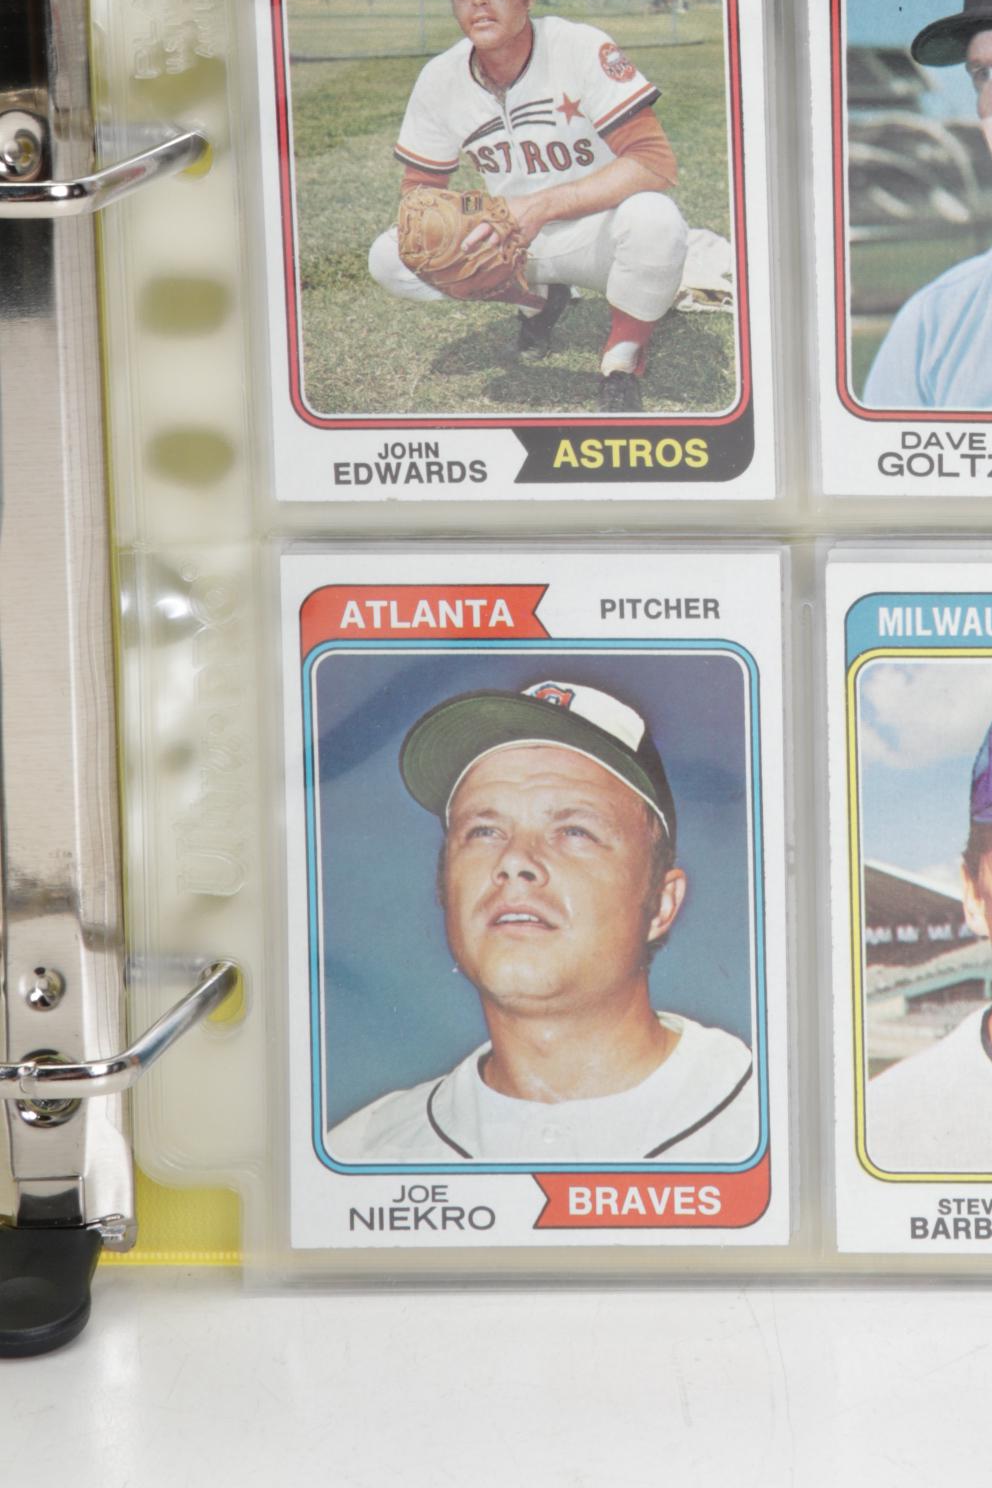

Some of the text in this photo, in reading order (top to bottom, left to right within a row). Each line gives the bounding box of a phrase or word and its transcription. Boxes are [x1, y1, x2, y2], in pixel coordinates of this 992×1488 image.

[377, 441, 440, 461] JOHN
[553, 437, 709, 469] ASTROS
[901, 431, 987, 451] DAVE
[333, 459, 488, 486] EDWARDS
[339, 598, 514, 629] ATLANTA
[600, 597, 720, 620] PITCHER
[392, 1184, 449, 1204] JOE
[568, 1185, 722, 1216] BRAVES
[349, 1205, 496, 1231] NIEKRO
